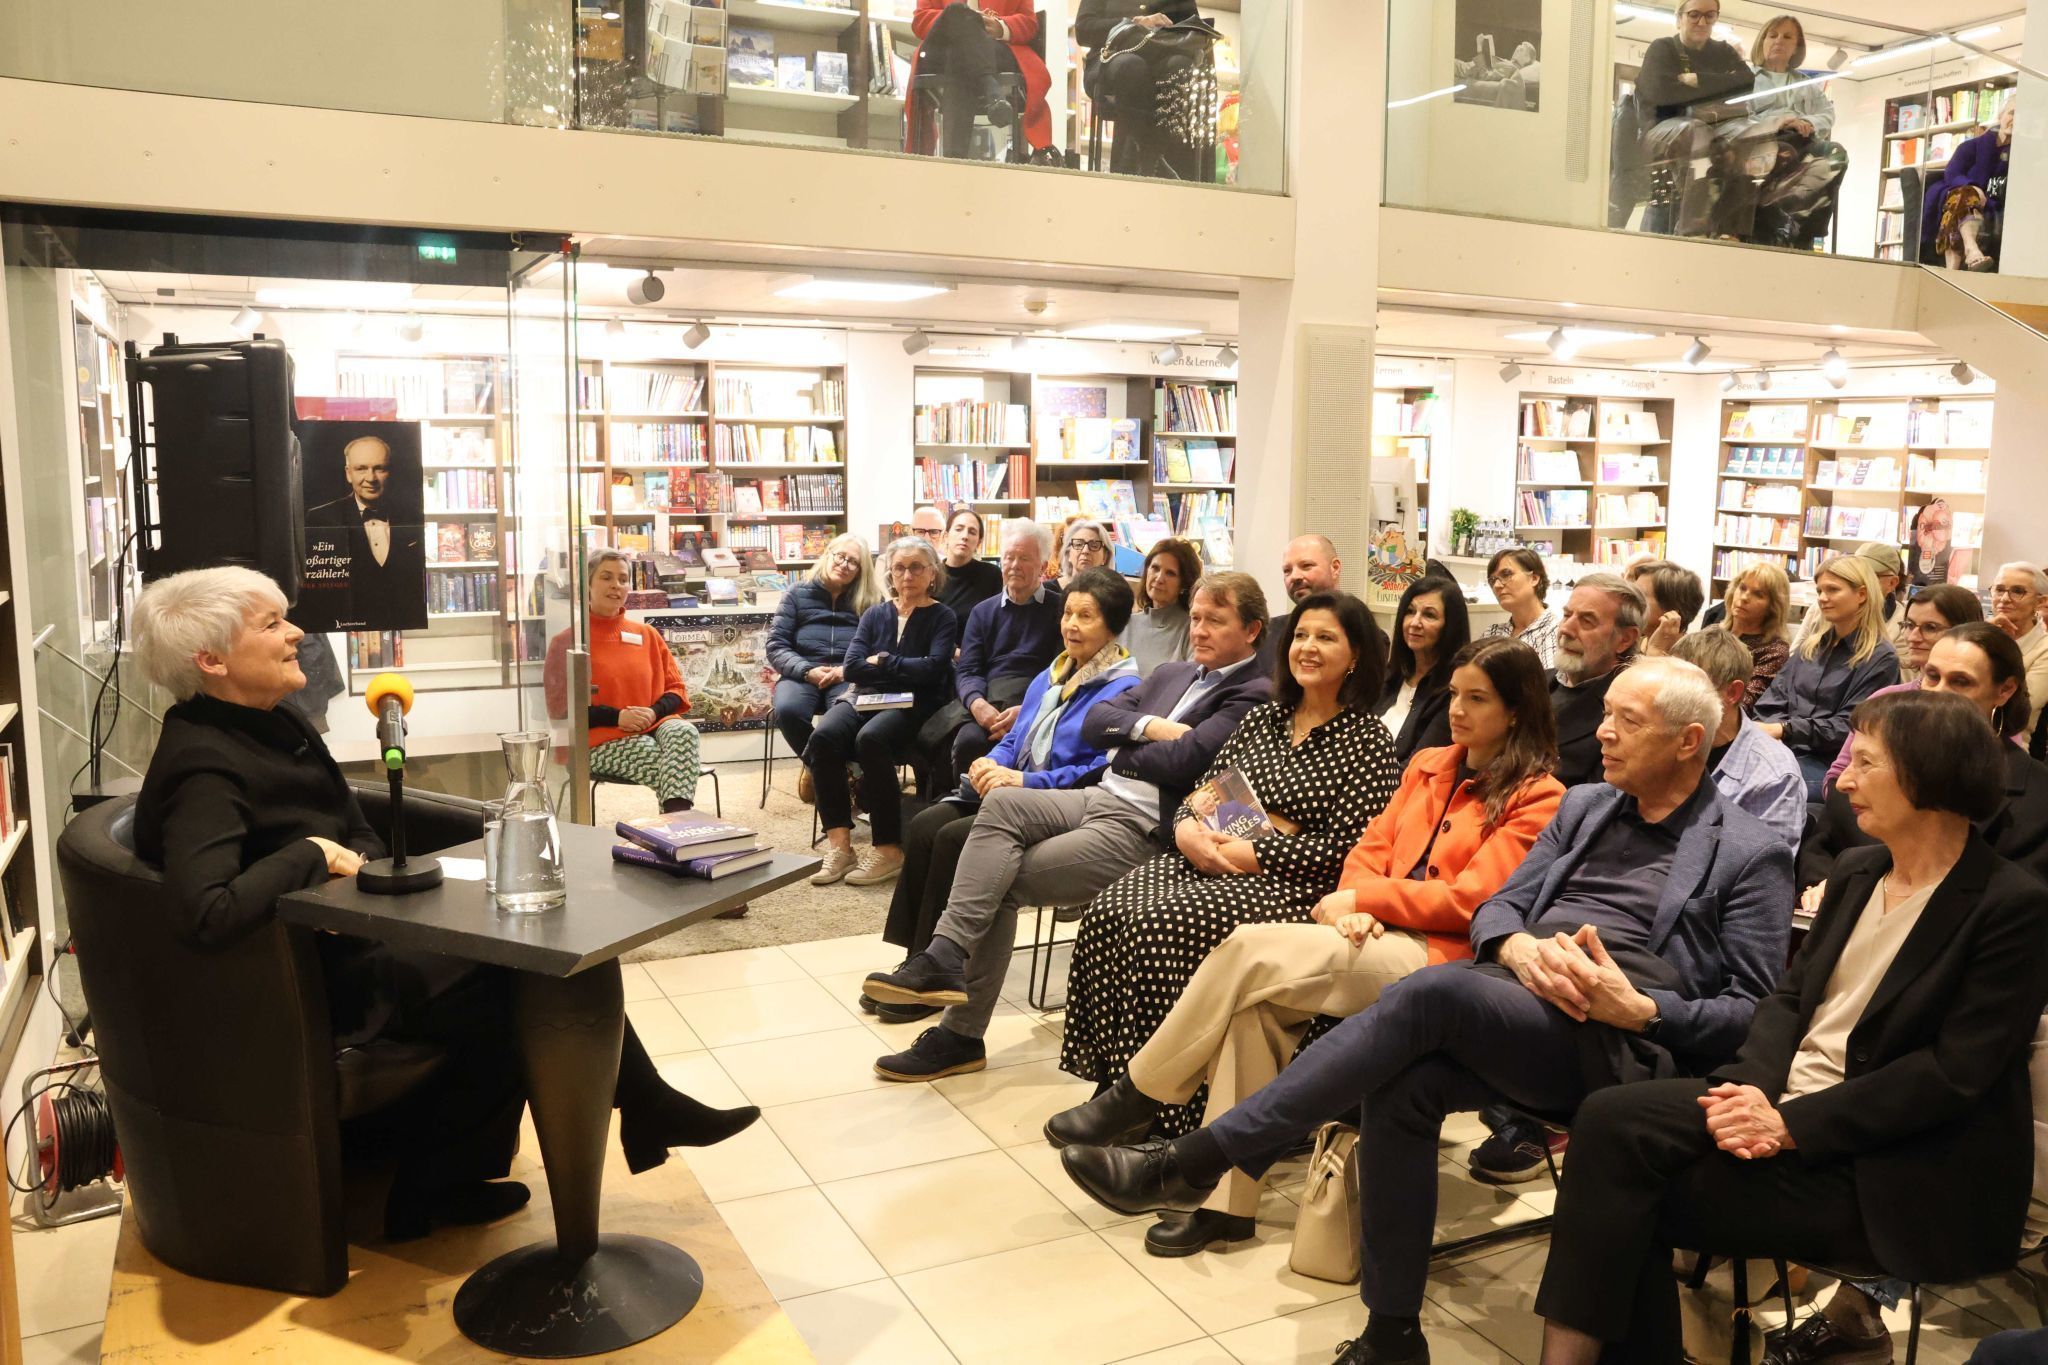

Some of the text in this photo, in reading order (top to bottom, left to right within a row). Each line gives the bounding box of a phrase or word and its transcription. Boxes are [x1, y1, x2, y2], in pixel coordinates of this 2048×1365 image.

[1186, 356, 1193, 366] &
[305, 554, 352, 568] oßartiger
[306, 568, 350, 579] rzähler!«
[1221, 814, 1247, 836] KING
[1230, 814, 1261, 838] ARLES
